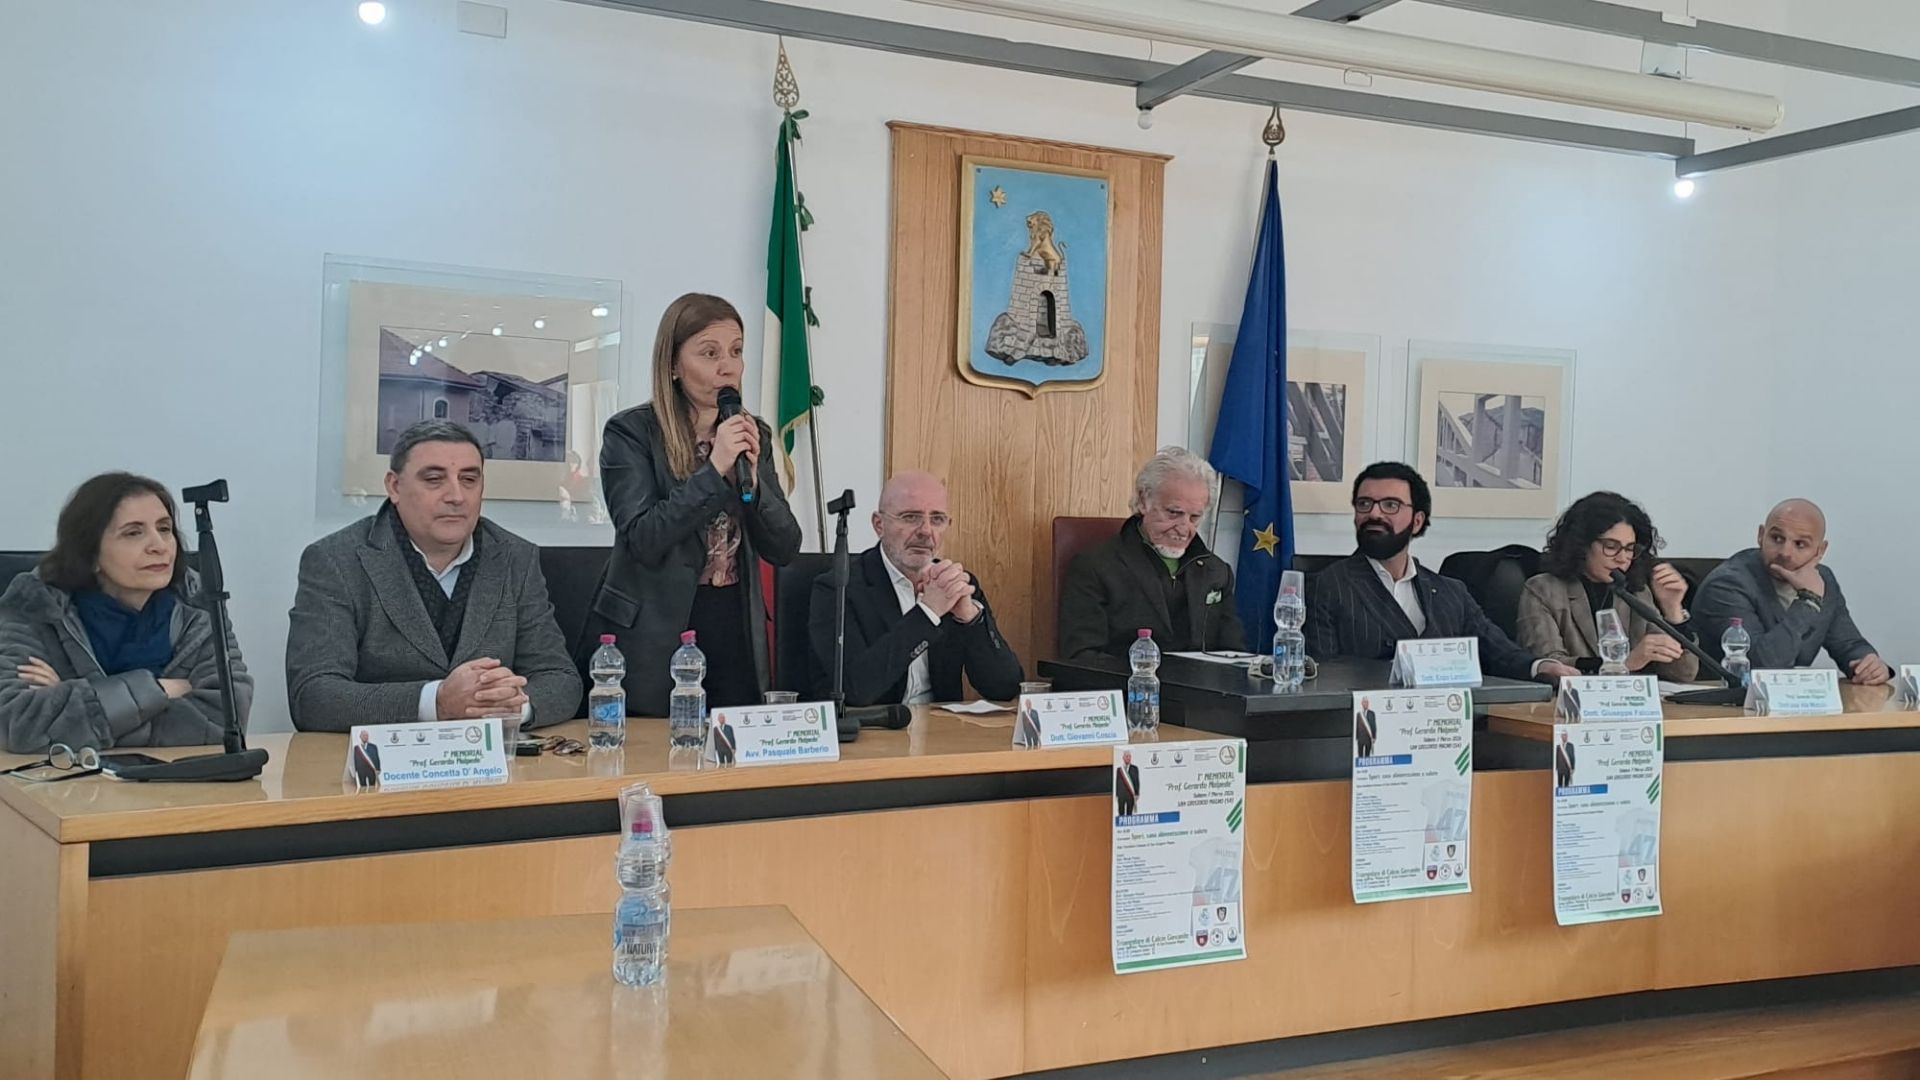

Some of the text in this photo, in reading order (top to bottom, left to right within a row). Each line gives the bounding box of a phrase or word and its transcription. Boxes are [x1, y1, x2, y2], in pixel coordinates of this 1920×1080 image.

[1067, 732, 1095, 740] Giovanni
[451, 749, 483, 758] MEMORIAL
[762, 747, 797, 757] Pasquale
[798, 746, 830, 755] Barberio
[1358, 755, 1393, 767] PROGRAMMA
[383, 770, 420, 781] Docente
[422, 768, 460, 779] Concetta
[473, 766, 503, 778] Angelo
[1204, 771, 1234, 781] MEMORIAL
[1183, 781, 1207, 790] Gerardo
[1118, 813, 1160, 826] PROGRAMMA
[1436, 808, 1467, 840] 47
[1627, 834, 1656, 865] 47
[1204, 866, 1239, 901] 47
